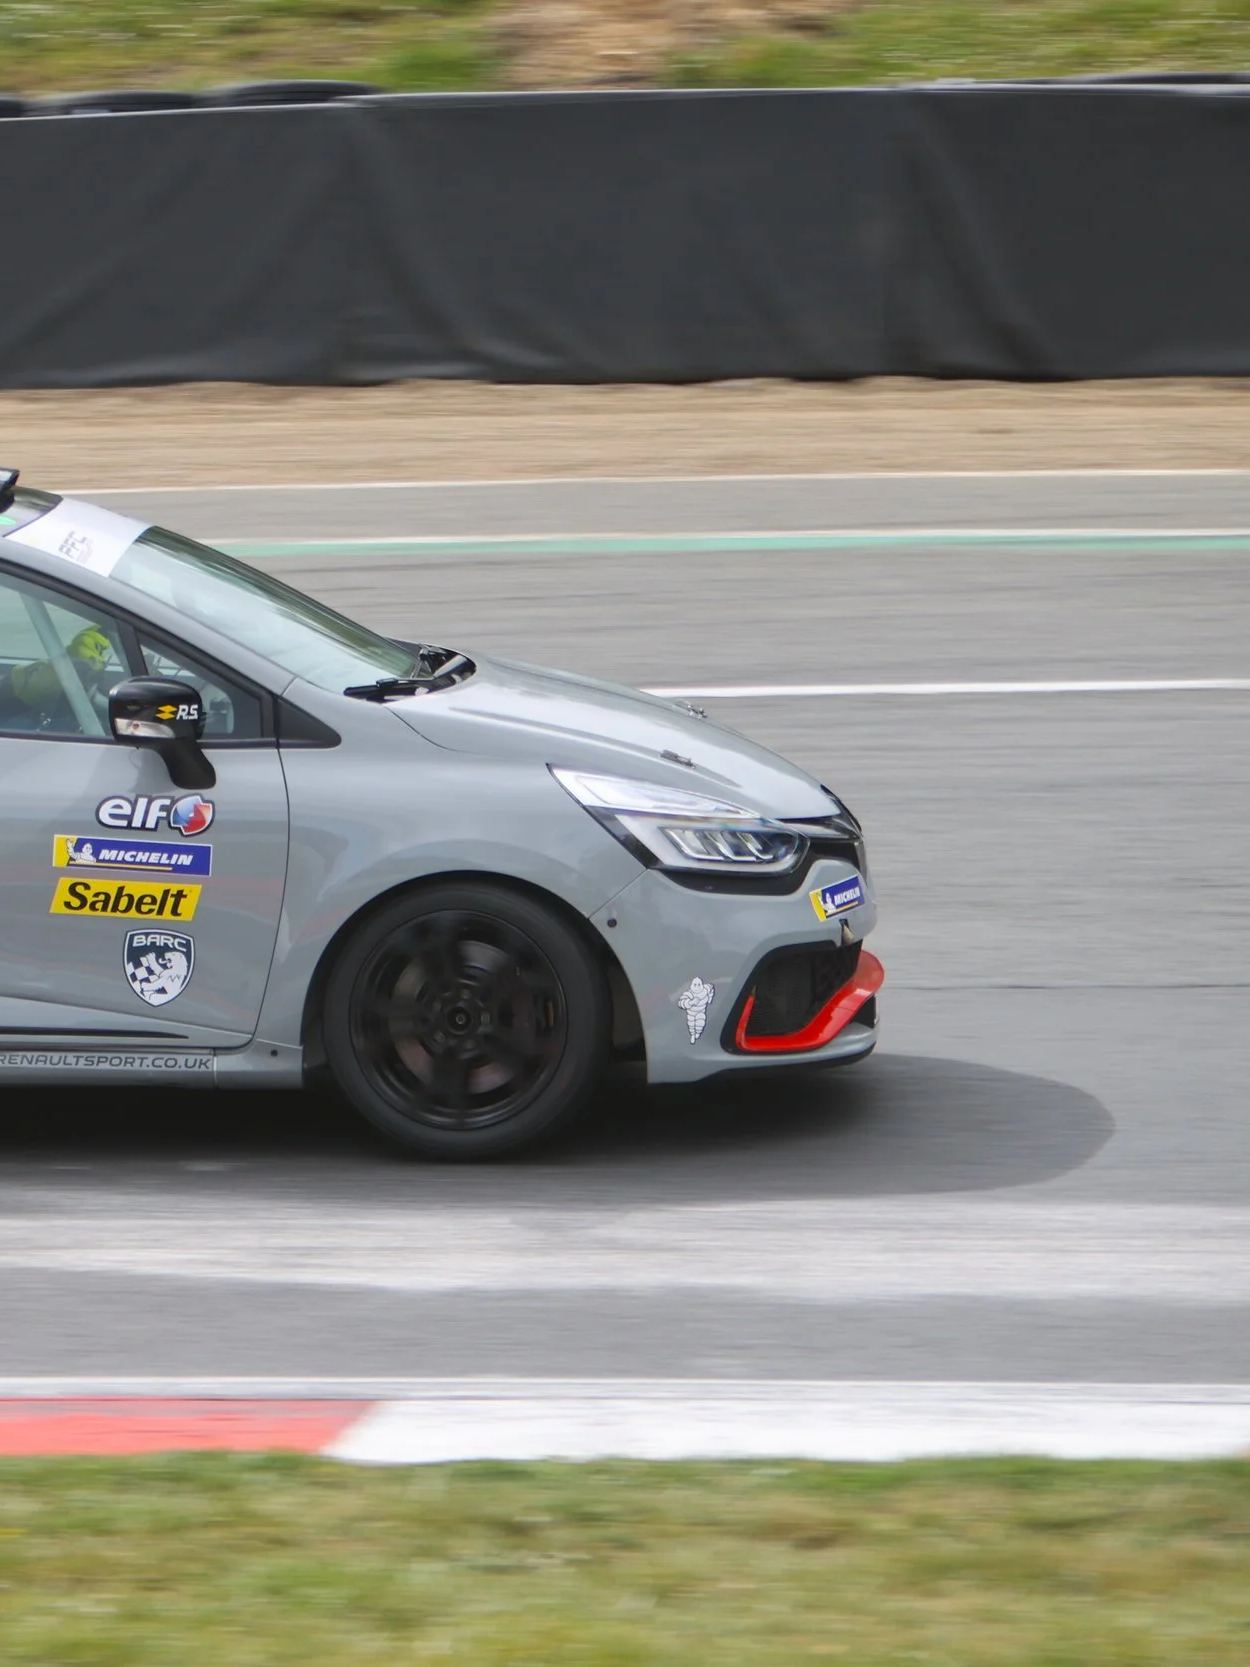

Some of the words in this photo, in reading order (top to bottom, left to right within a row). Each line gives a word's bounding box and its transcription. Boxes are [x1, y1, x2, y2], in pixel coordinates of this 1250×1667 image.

[98, 797, 171, 829] elf
[99, 848, 194, 867] MICHELIN
[63, 882, 188, 917] Sabelt
[834, 887, 861, 906] MICHELIN
[132, 934, 187, 951] BARC
